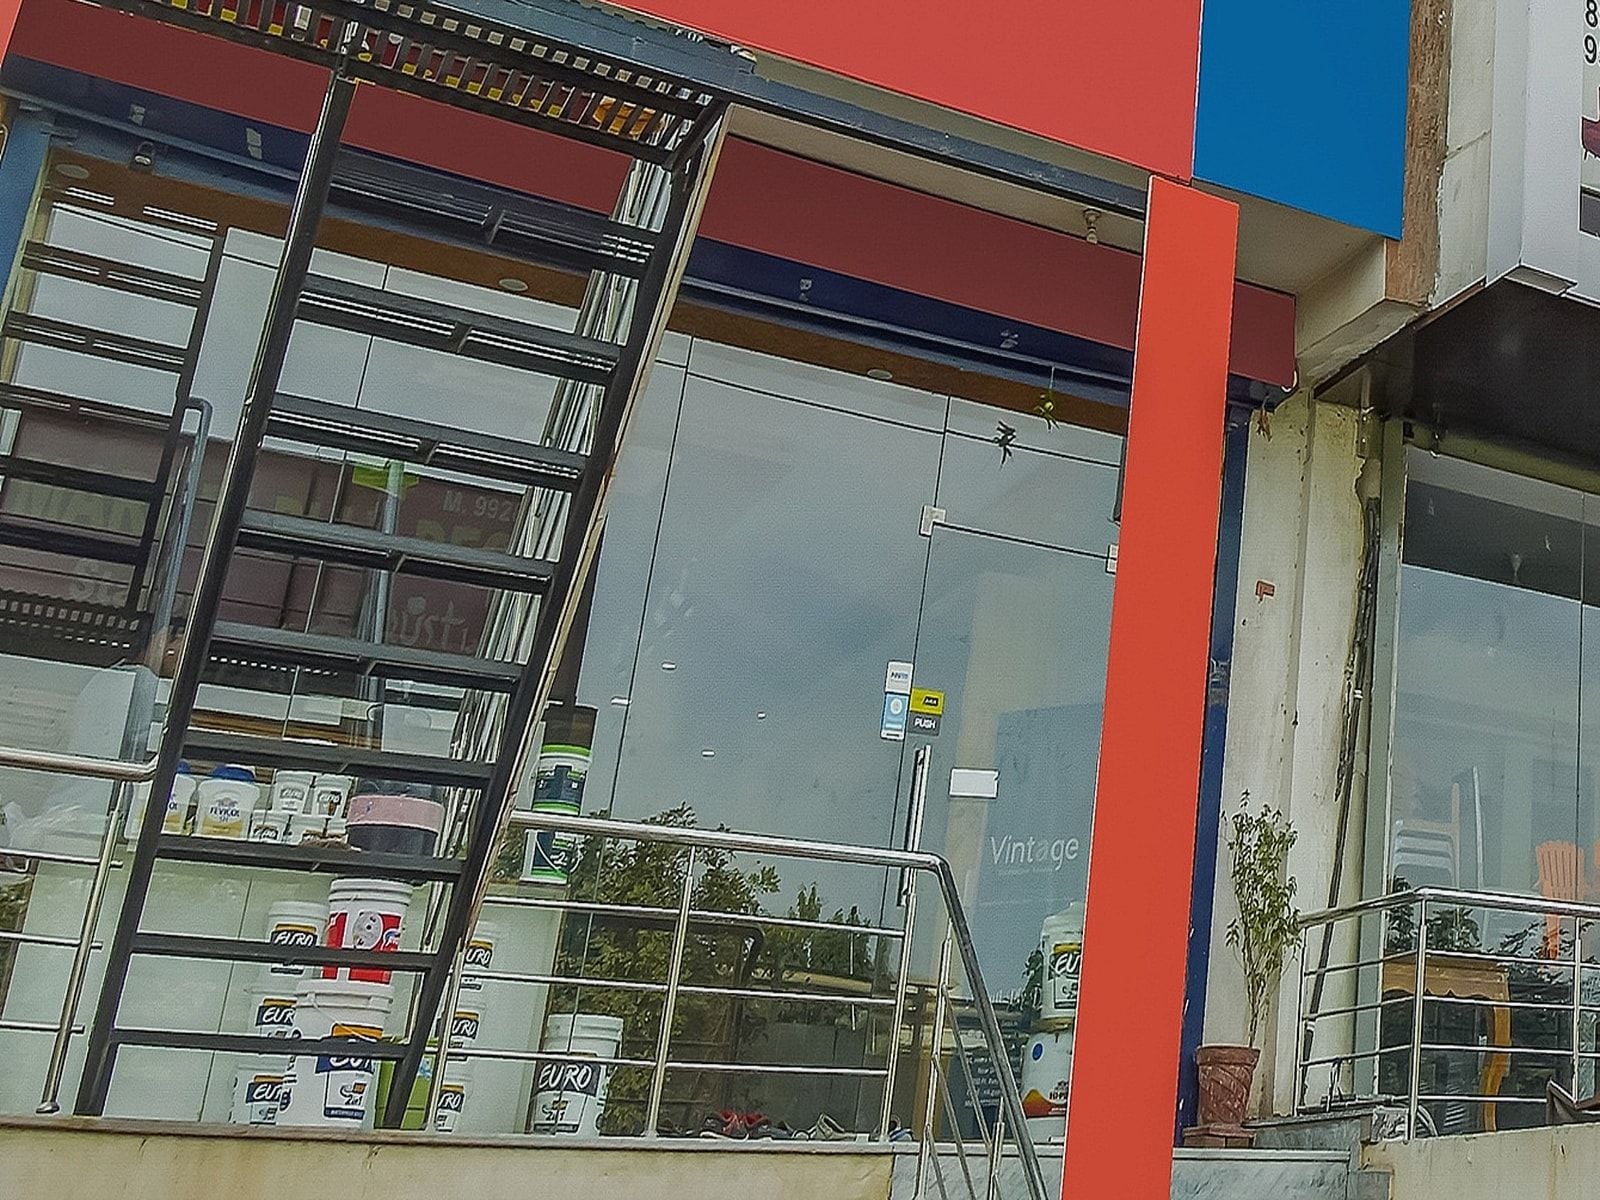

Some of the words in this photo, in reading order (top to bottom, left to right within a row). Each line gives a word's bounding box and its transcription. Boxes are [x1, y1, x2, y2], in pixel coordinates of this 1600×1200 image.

[473, 495, 514, 522] 992
[914, 717, 936, 729] PUSH
[990, 835, 1079, 870] Vintage
[465, 948, 491, 966] URO
[1055, 954, 1081, 975] EU
[262, 1007, 295, 1025] EUR
[453, 1019, 477, 1037] URO
[538, 1063, 593, 1092] EURO
[253, 1086, 282, 1101] EUR
[438, 1091, 462, 1109] RO
